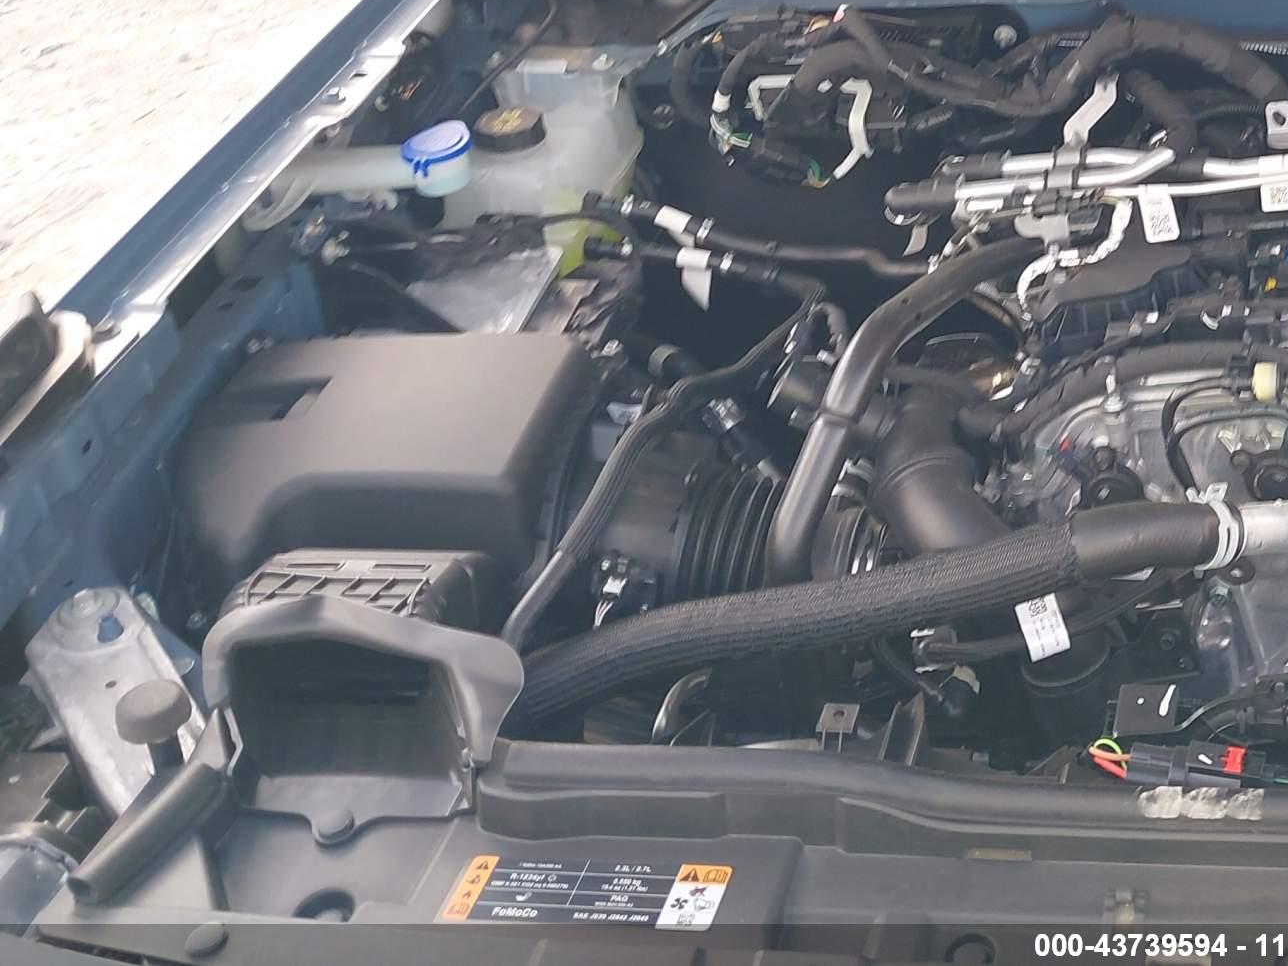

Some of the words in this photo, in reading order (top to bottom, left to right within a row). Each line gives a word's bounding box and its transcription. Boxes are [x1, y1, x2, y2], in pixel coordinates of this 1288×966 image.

[510, 873, 546, 883] R-1234yf
[610, 894, 629, 902] PAG
[491, 906, 538, 918] FoMoCo
